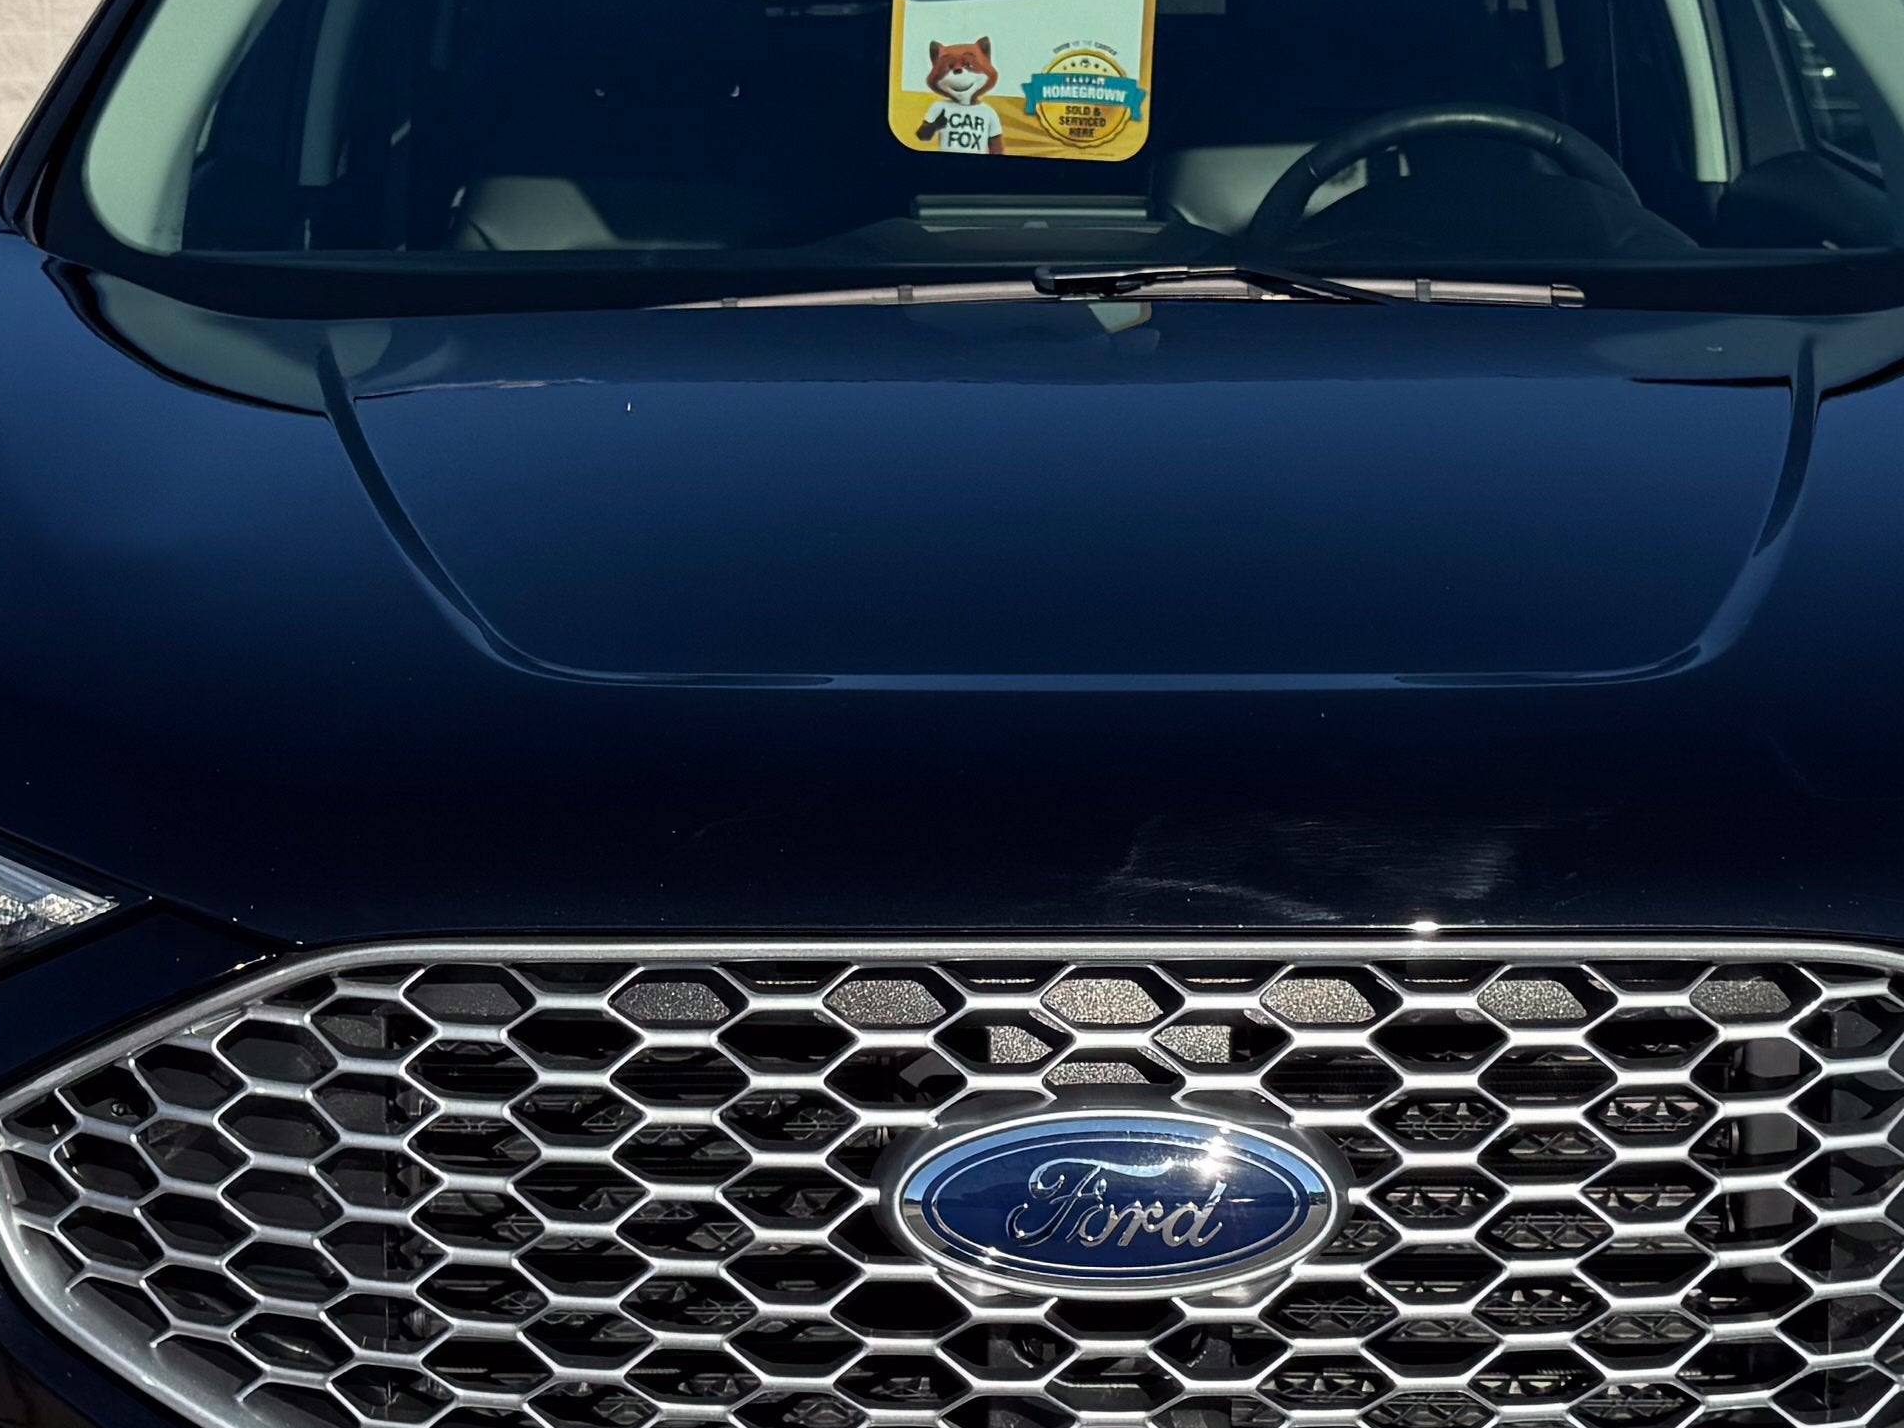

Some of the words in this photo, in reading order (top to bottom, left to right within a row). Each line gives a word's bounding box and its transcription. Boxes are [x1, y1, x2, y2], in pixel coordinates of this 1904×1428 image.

[1042, 85, 1127, 103] HOMEGROWN
[949, 113, 985, 132] CAR
[948, 131, 982, 150] FOX
[1005, 1157, 1227, 1247] Ford
